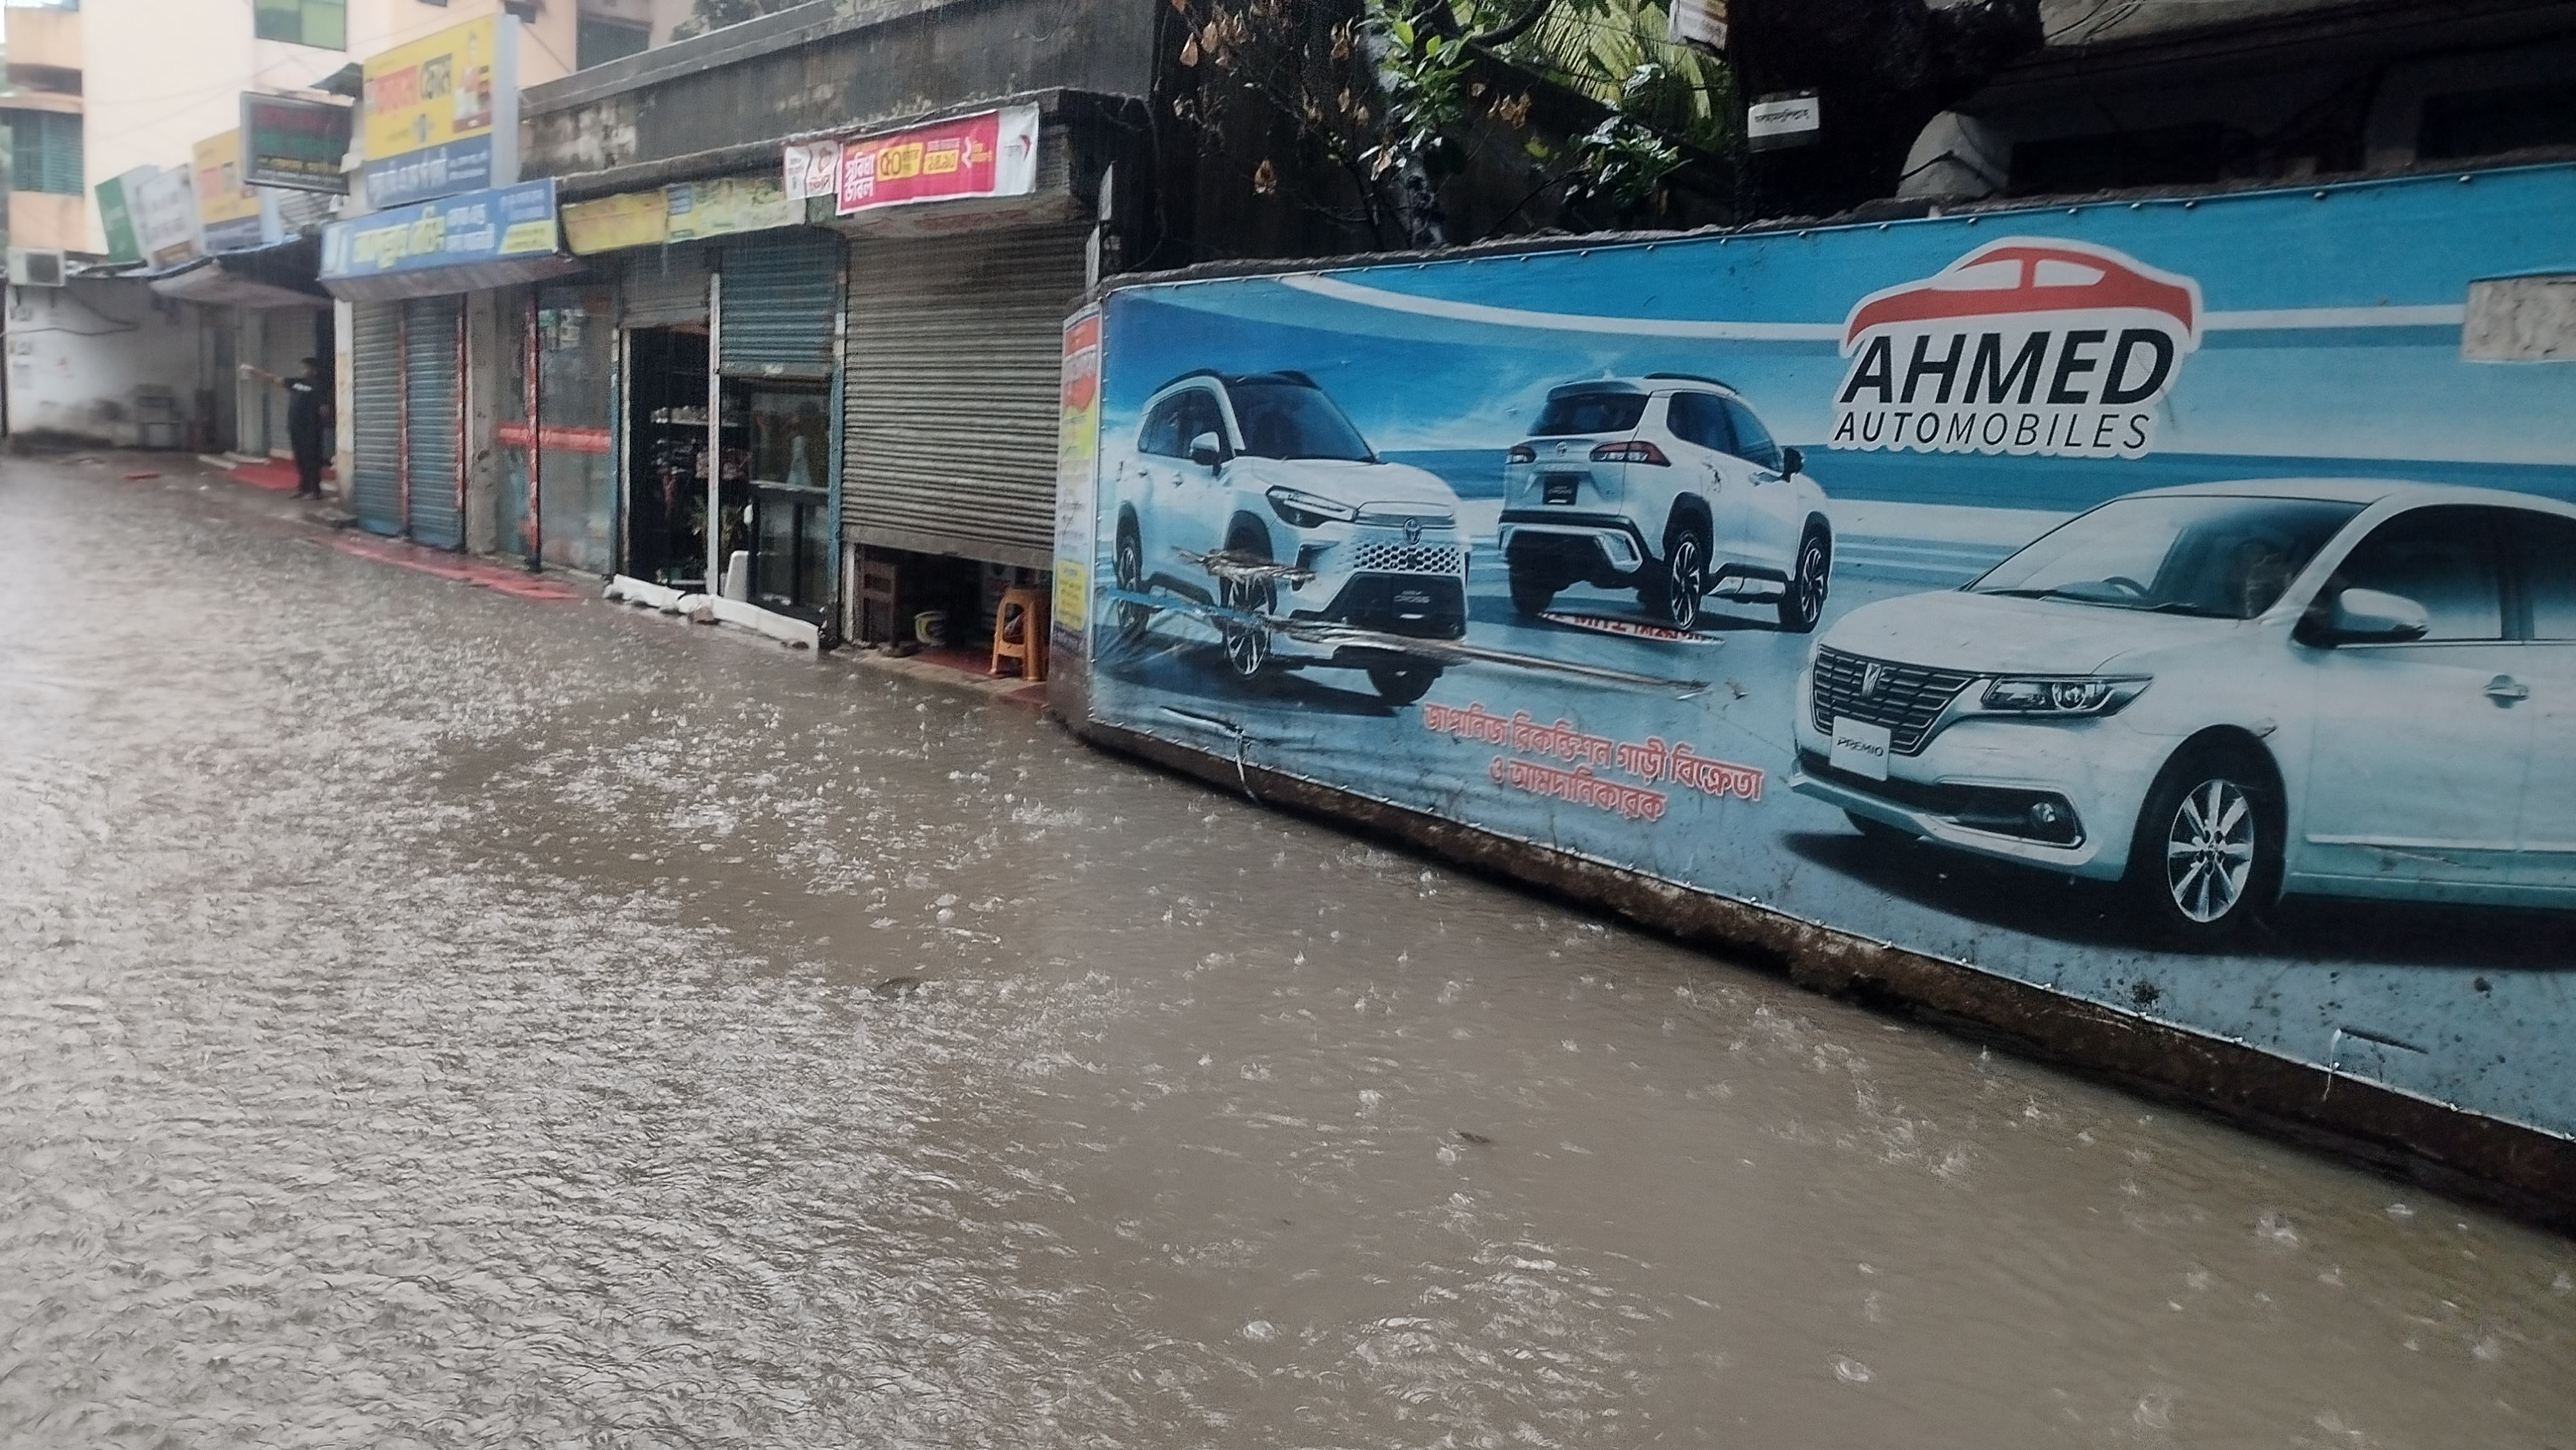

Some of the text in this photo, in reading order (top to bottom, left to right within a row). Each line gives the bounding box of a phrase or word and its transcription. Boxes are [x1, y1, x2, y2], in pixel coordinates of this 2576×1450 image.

[1840, 328, 2174, 405] AHMED
[1834, 411, 2150, 449] AUTOMOBILES
[1424, 701, 1765, 802] জাপানিজ রিকন্ডিশন গাড়ী বিক্রেতা
[1837, 736, 1884, 757] PREMIO
[1489, 754, 1667, 823] ও আমদানিকারক
